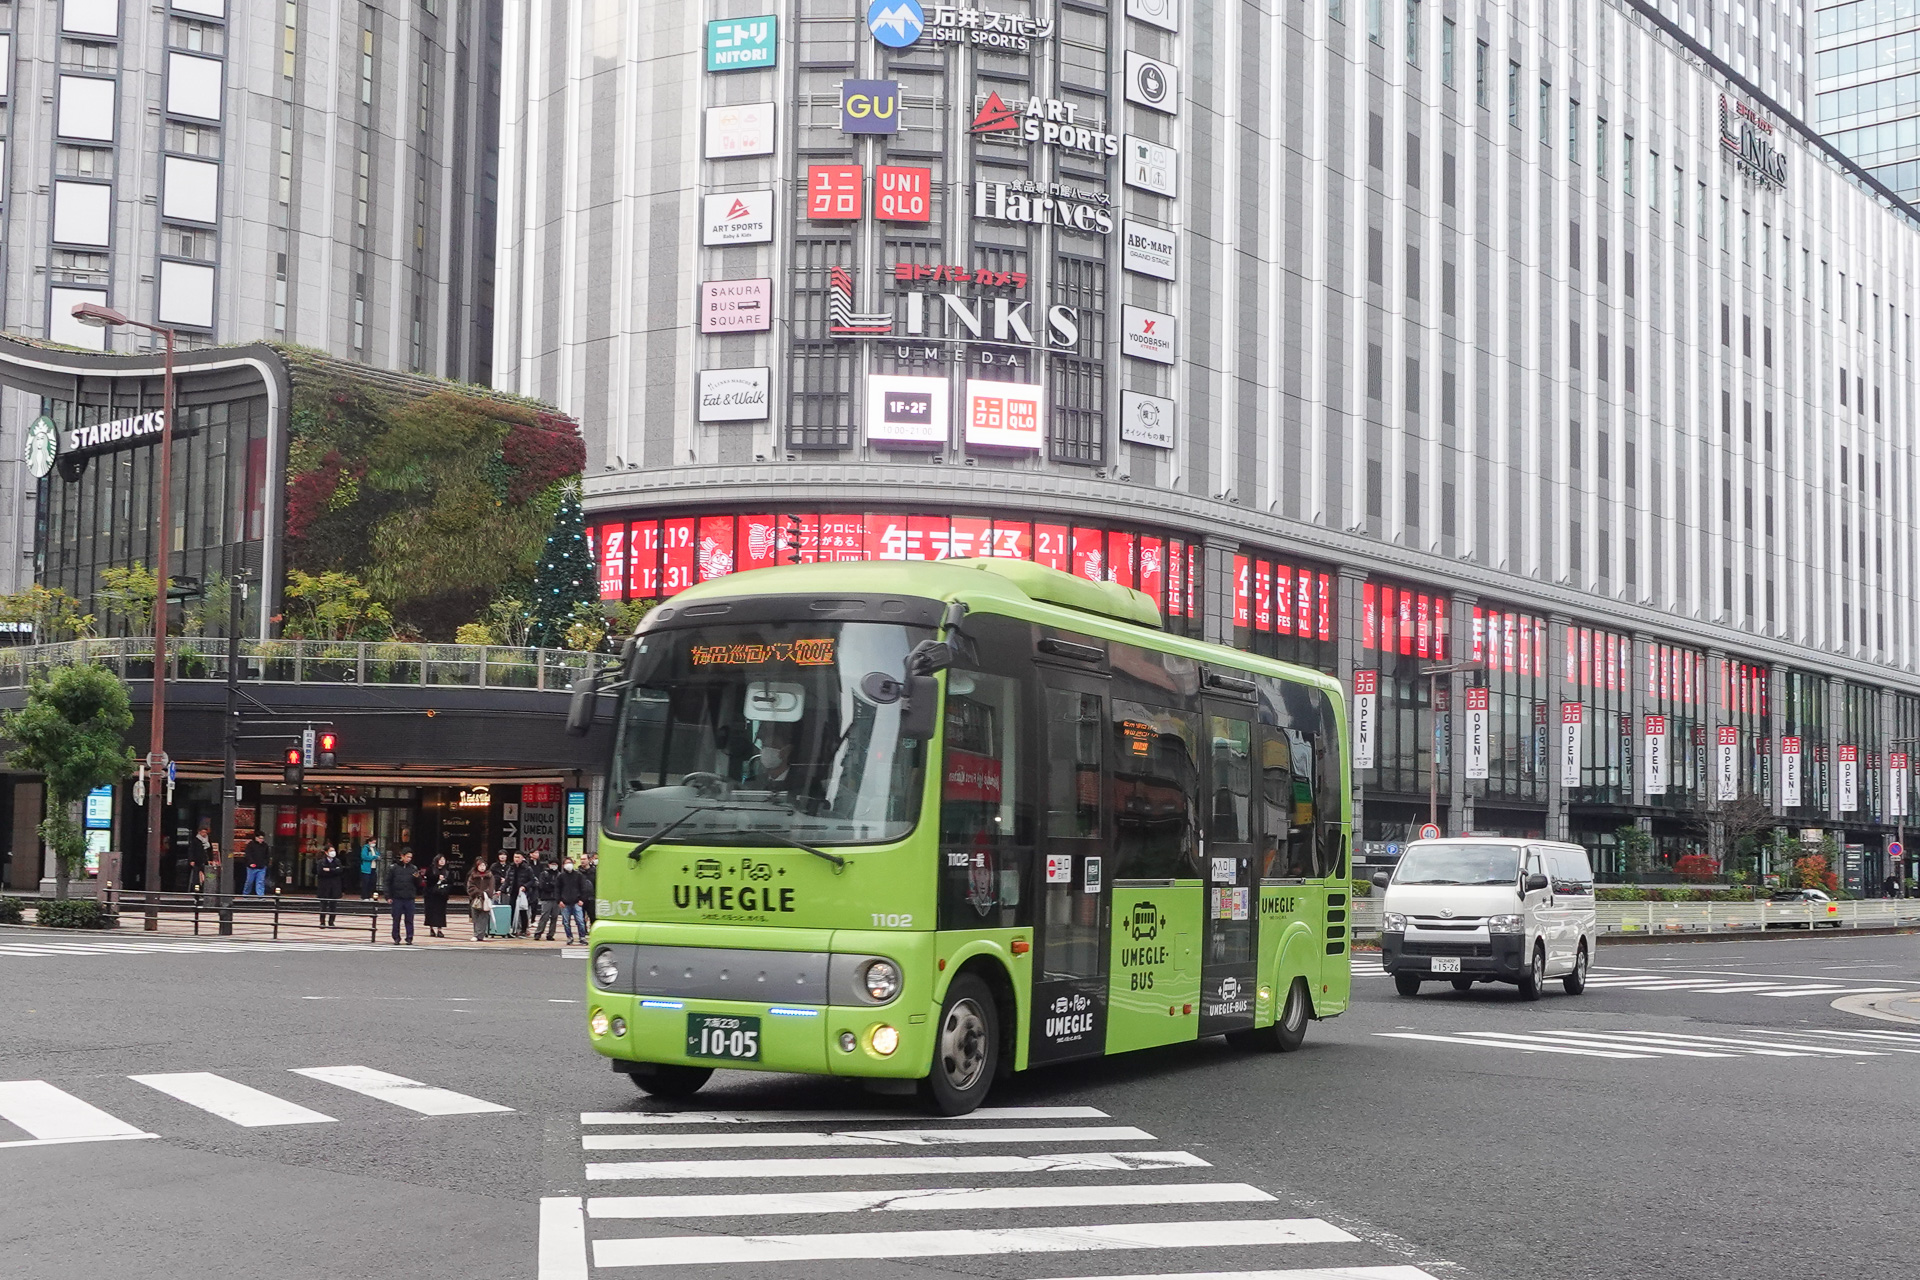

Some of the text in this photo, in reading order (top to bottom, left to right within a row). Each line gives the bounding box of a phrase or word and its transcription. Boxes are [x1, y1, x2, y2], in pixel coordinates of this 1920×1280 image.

[933, 5, 1054, 38] 石井スポーツ
[716, 22, 768, 48] ニトリ
[933, 27, 1028, 50] ISHII SPORTS
[715, 48, 768, 64] NITORI
[846, 94, 894, 119] GU
[1026, 96, 1079, 124] ART
[1024, 119, 1118, 156] SPORTS
[974, 182, 1114, 235] Harves
[712, 222, 763, 233] ART SPORTS
[1127, 233, 1173, 255] ABC-MART
[895, 262, 1028, 289] ヨドバシカメラ
[710, 285, 762, 297] SAKURA
[710, 302, 736, 312] BUS
[710, 314, 762, 327] SQUARE
[1128, 332, 1170, 350] YODOBASHI
[897, 345, 1019, 367] UMEDA
[702, 390, 765, 407] Eat & Walk
[1142, 409, 1155, 420] 横丁
[70, 410, 165, 450] STARBUCKS
[1124, 428, 1172, 444] オイシイもの横丁
[800, 523, 872, 535] ユニクロには、
[800, 535, 860, 548] フクがある。
[690, 642, 796, 666] 梅田巡回バス
[1360, 697, 1368, 755] OPEN!
[1473, 712, 1481, 766] OPEN!
[1567, 725, 1575, 775] OPEN!
[1651, 737, 1659, 783] OPEN!
[523, 812, 555, 824] UNIQLO
[523, 825, 554, 835] UMEDA
[1424, 830, 1436, 839] 40
[1217, 860, 1228, 871] 入口
[672, 884, 796, 913] UMEGLE
[1261, 896, 1296, 914] UMEGLE
[871, 913, 914, 928] 1102
[1438, 963, 1459, 972] 15-26
[1130, 971, 1154, 991] BUS
[1045, 1012, 1094, 1038] UMEGLE
[700, 1027, 758, 1058] 10-05
